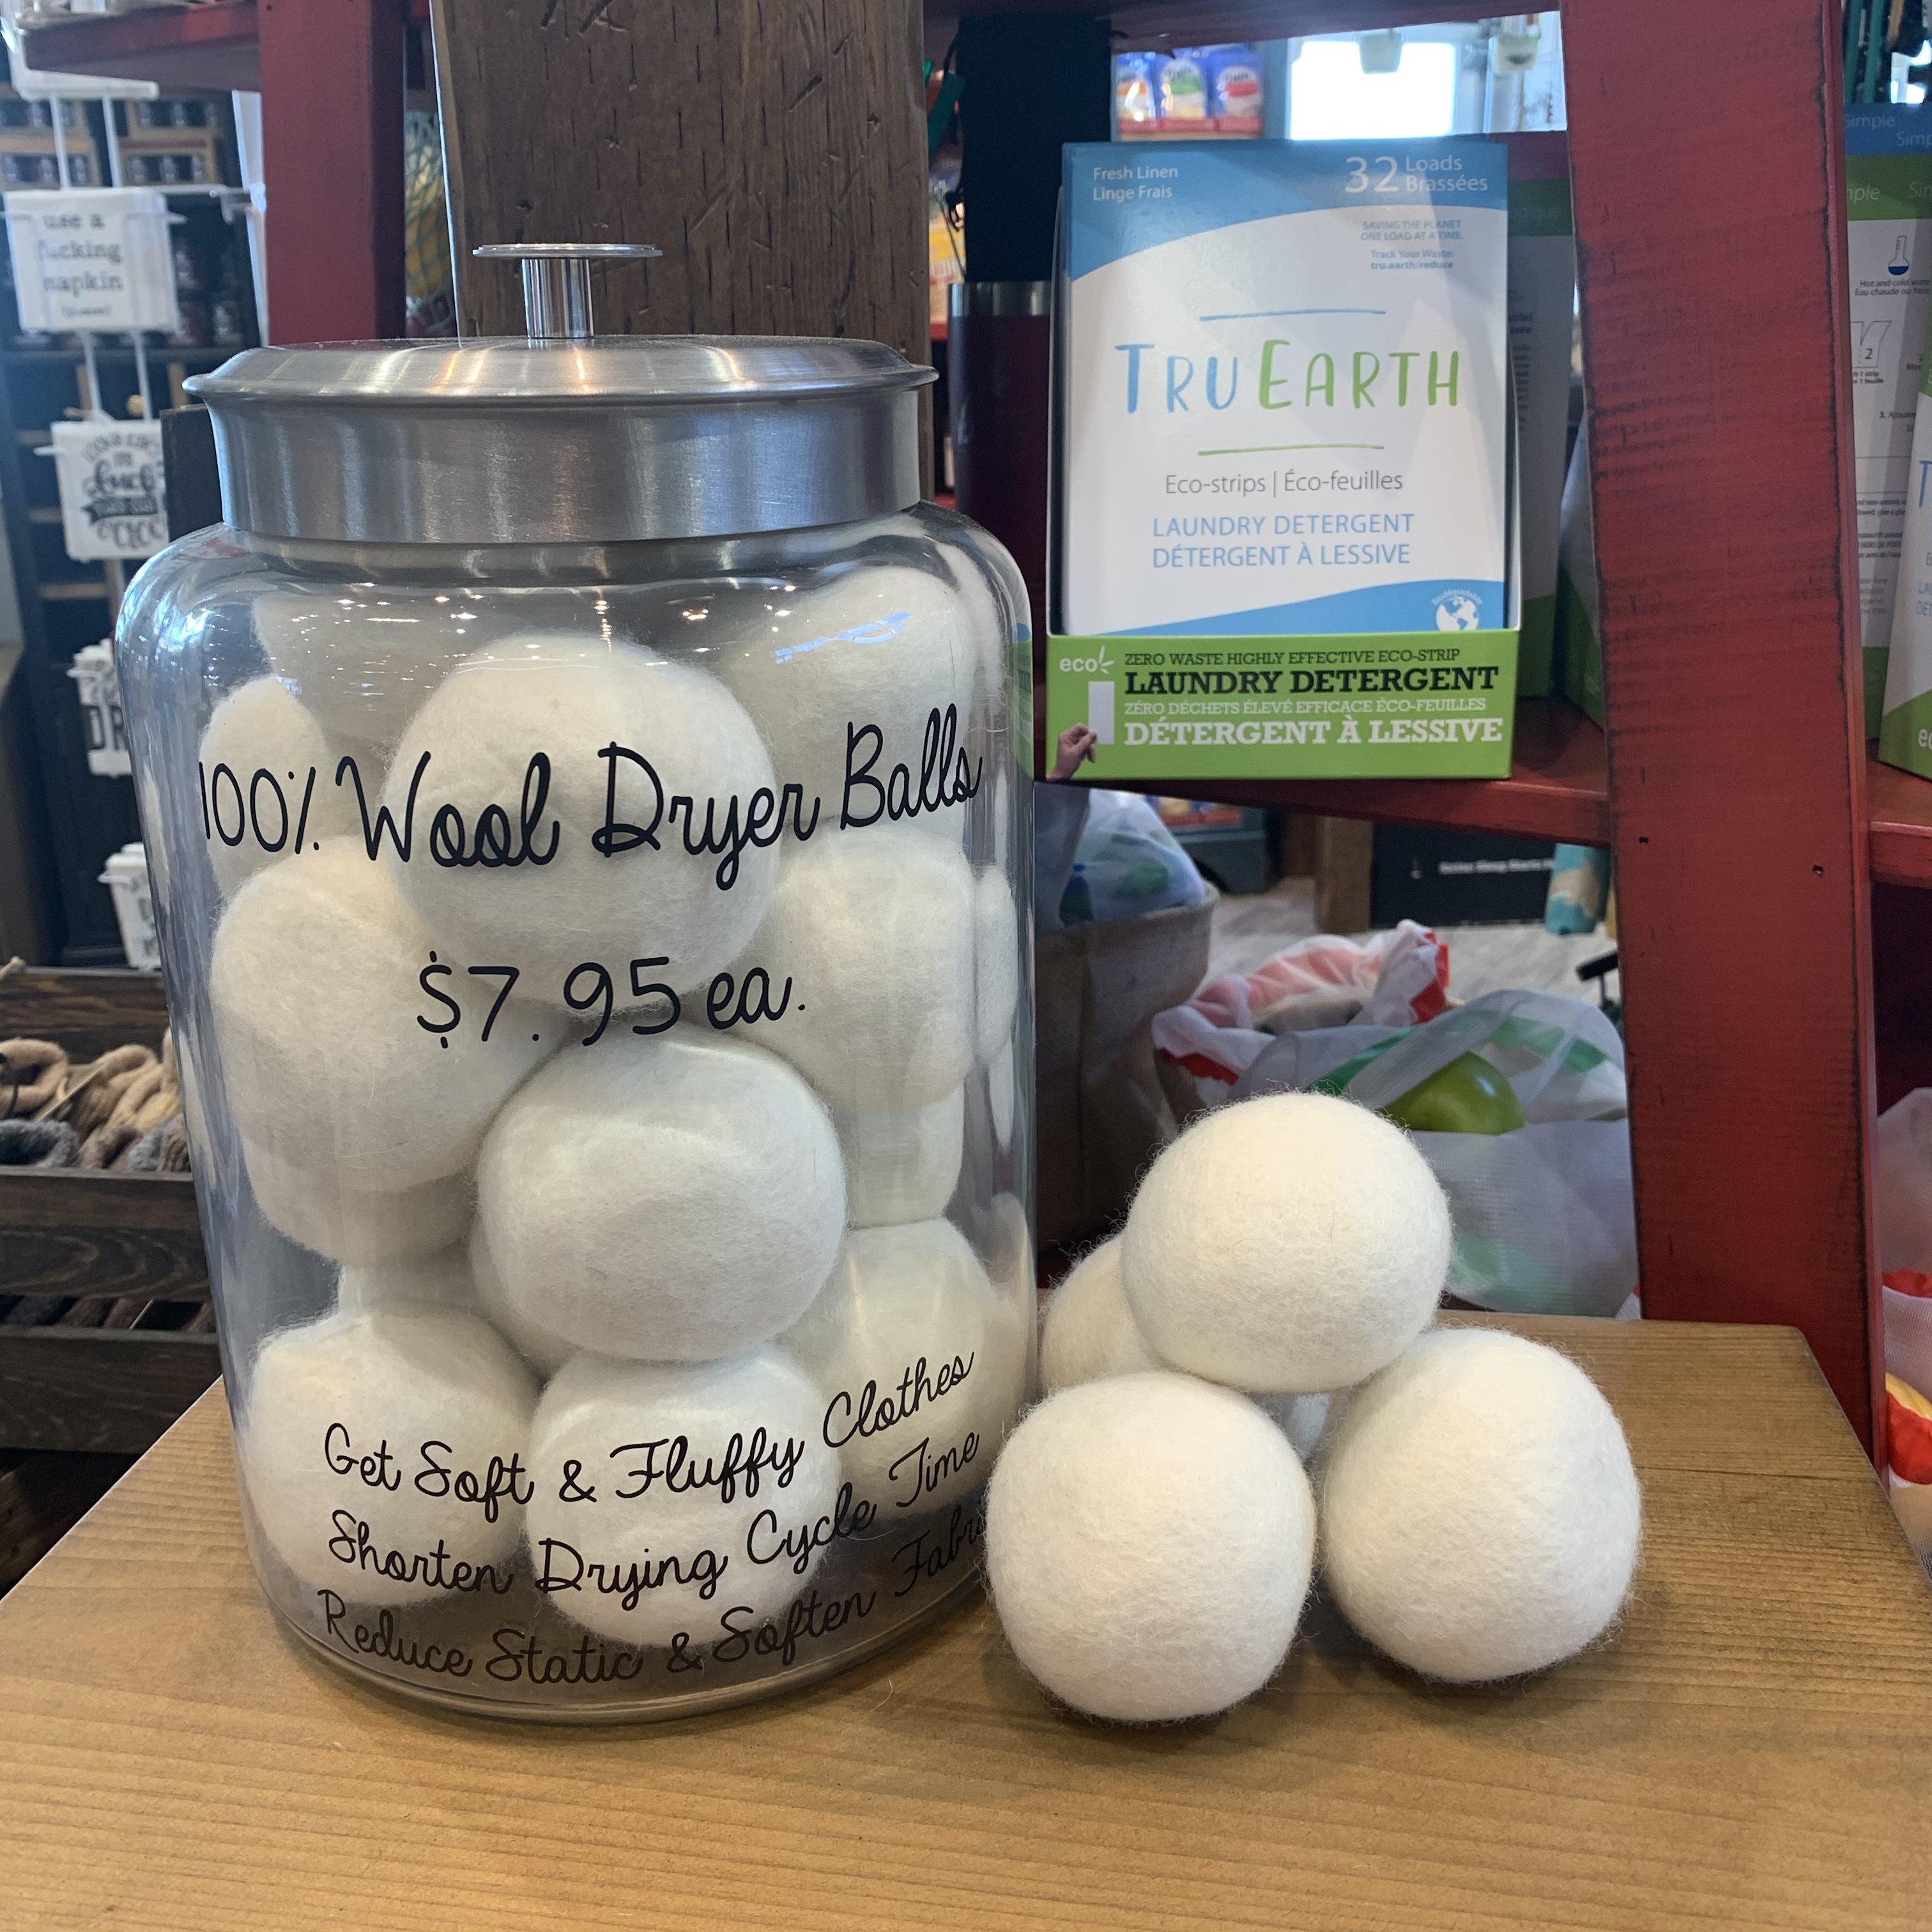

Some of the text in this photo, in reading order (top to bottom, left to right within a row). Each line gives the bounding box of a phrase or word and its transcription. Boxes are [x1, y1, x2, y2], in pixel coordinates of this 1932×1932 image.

[1093, 165, 1179, 180] Fresh Linen
[1344, 154, 1463, 193] 32 Loads
[1406, 174, 1489, 192] Brassées
[1093, 184, 1173, 202] Linge Frais
[1363, 220, 1462, 230] SAVING THE PLANET
[1360, 232, 1382, 241] ONE
[1384, 231, 1413, 241] LOAD
[1414, 231, 1426, 240] AT
[1428, 231, 1436, 240] A
[1370, 250, 1395, 259] Track
[1399, 250, 1420, 258] Your
[1370, 260, 1454, 270] tru.earth/reduce
[1153, 513, 1415, 537] LAUNDRY DETERGENT
[1153, 541, 1411, 569] DÉTERGENT À LESSIVE
[1059, 656, 1099, 672] eco
[1124, 648, 1460, 666] ZERO WASTE HIGHLY EFFECTIVE ECO-STRIP
[1124, 666, 1499, 695] LAUNDRY DETERGENT
[1124, 697, 1487, 715] ZÉRO DÉCHETS ÉLEVÉ EFFICACE ÉCO-FEUILLES
[1124, 714, 1503, 746] DÉTERGENT À LESSIVE
[199, 703, 983, 891] 100% Wool Dryer Balls
[707, 967, 806, 1030] ea.
[325, 1351, 975, 1524] Get Soft & Fluffy Clothes
[328, 1431, 980, 1611] Shorten Drying Cycle Time
[316, 1494, 986, 1685] Reduce Static & Soften Fabri
